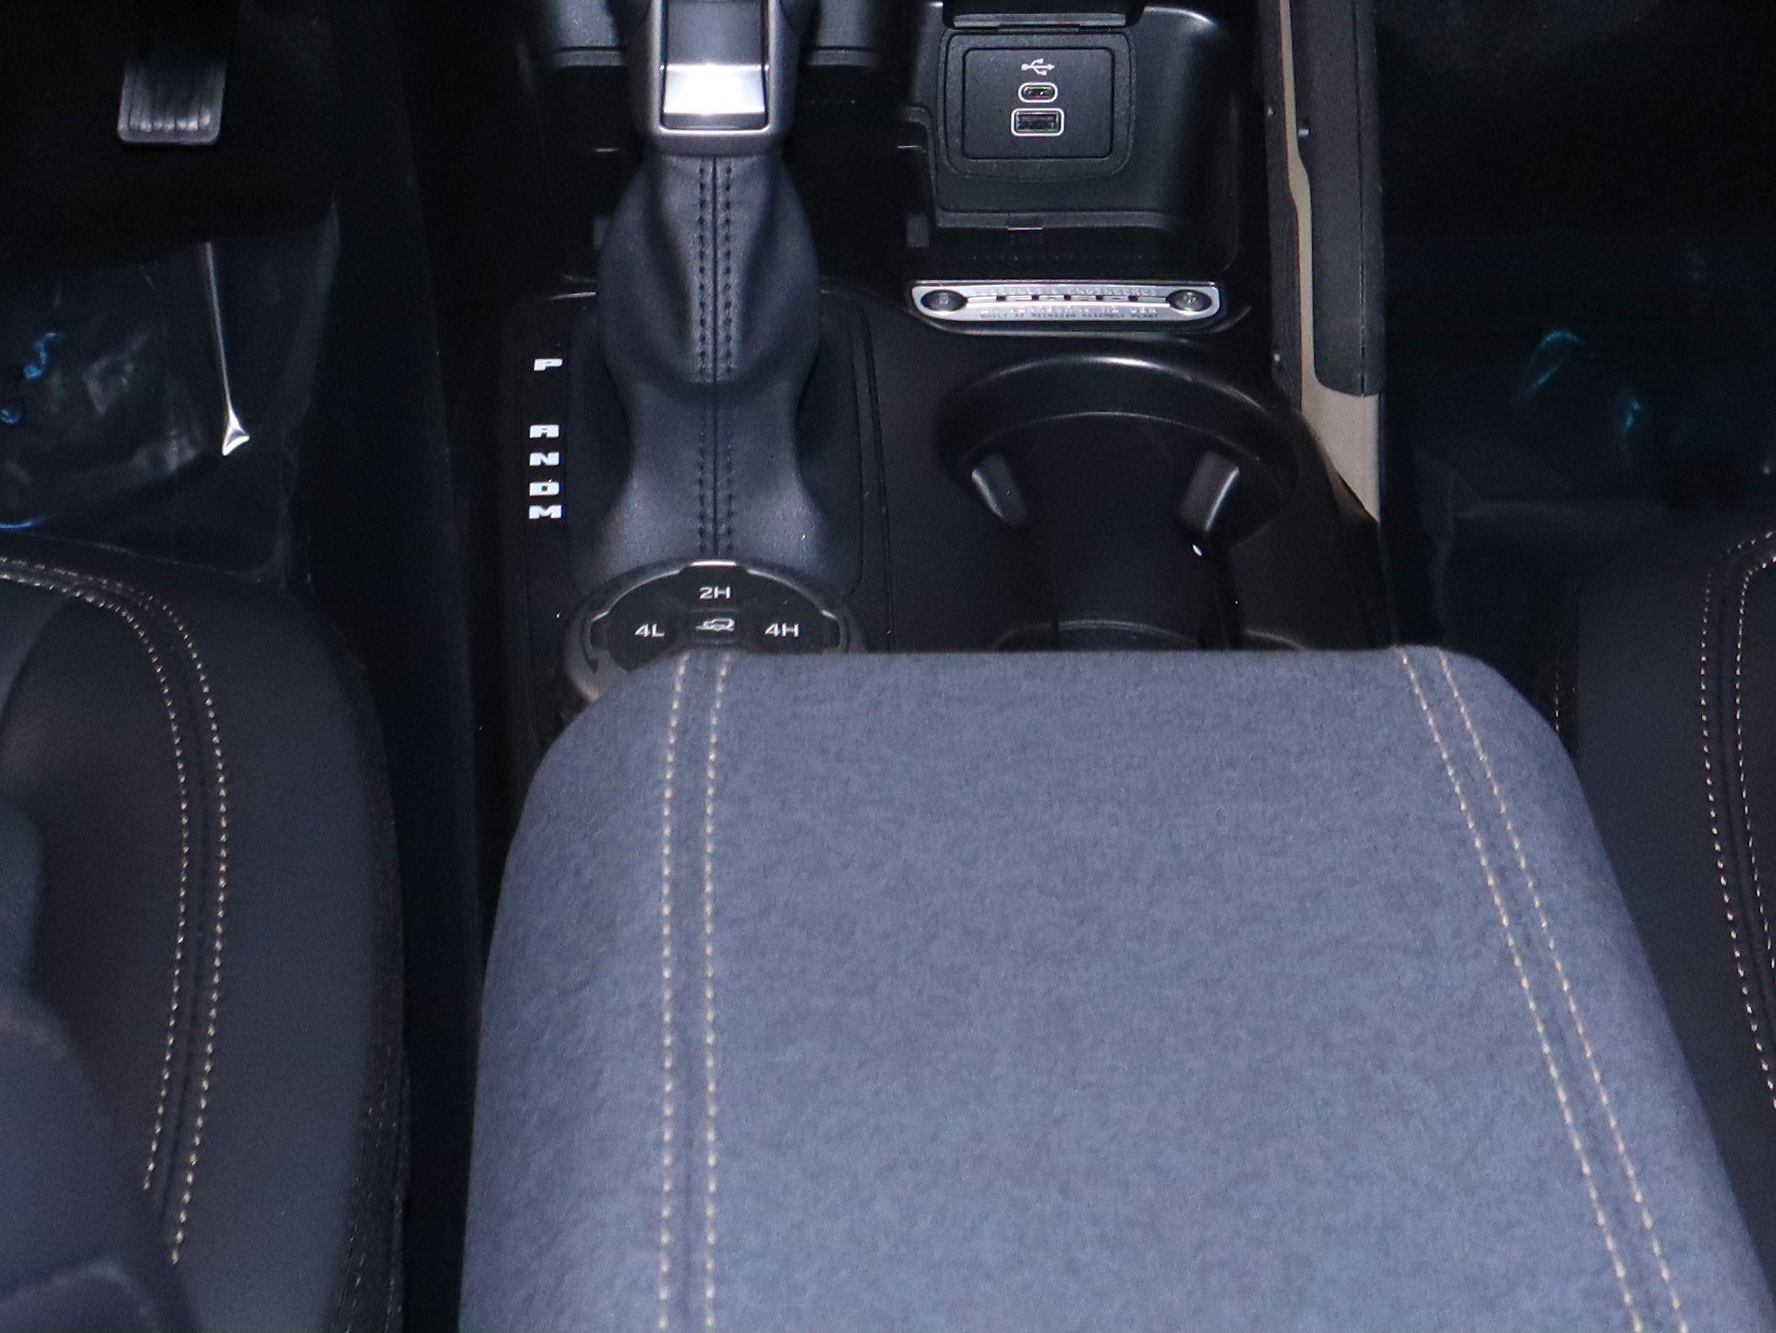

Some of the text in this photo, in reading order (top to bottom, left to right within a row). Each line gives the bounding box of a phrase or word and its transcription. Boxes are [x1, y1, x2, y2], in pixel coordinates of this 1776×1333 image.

[533, 358, 563, 371] P
[529, 452, 560, 467] N
[529, 482, 560, 496] D
[528, 505, 562, 519] M
[699, 586, 731, 599] 2H
[635, 623, 665, 637] 4L
[765, 623, 799, 637] 4H
